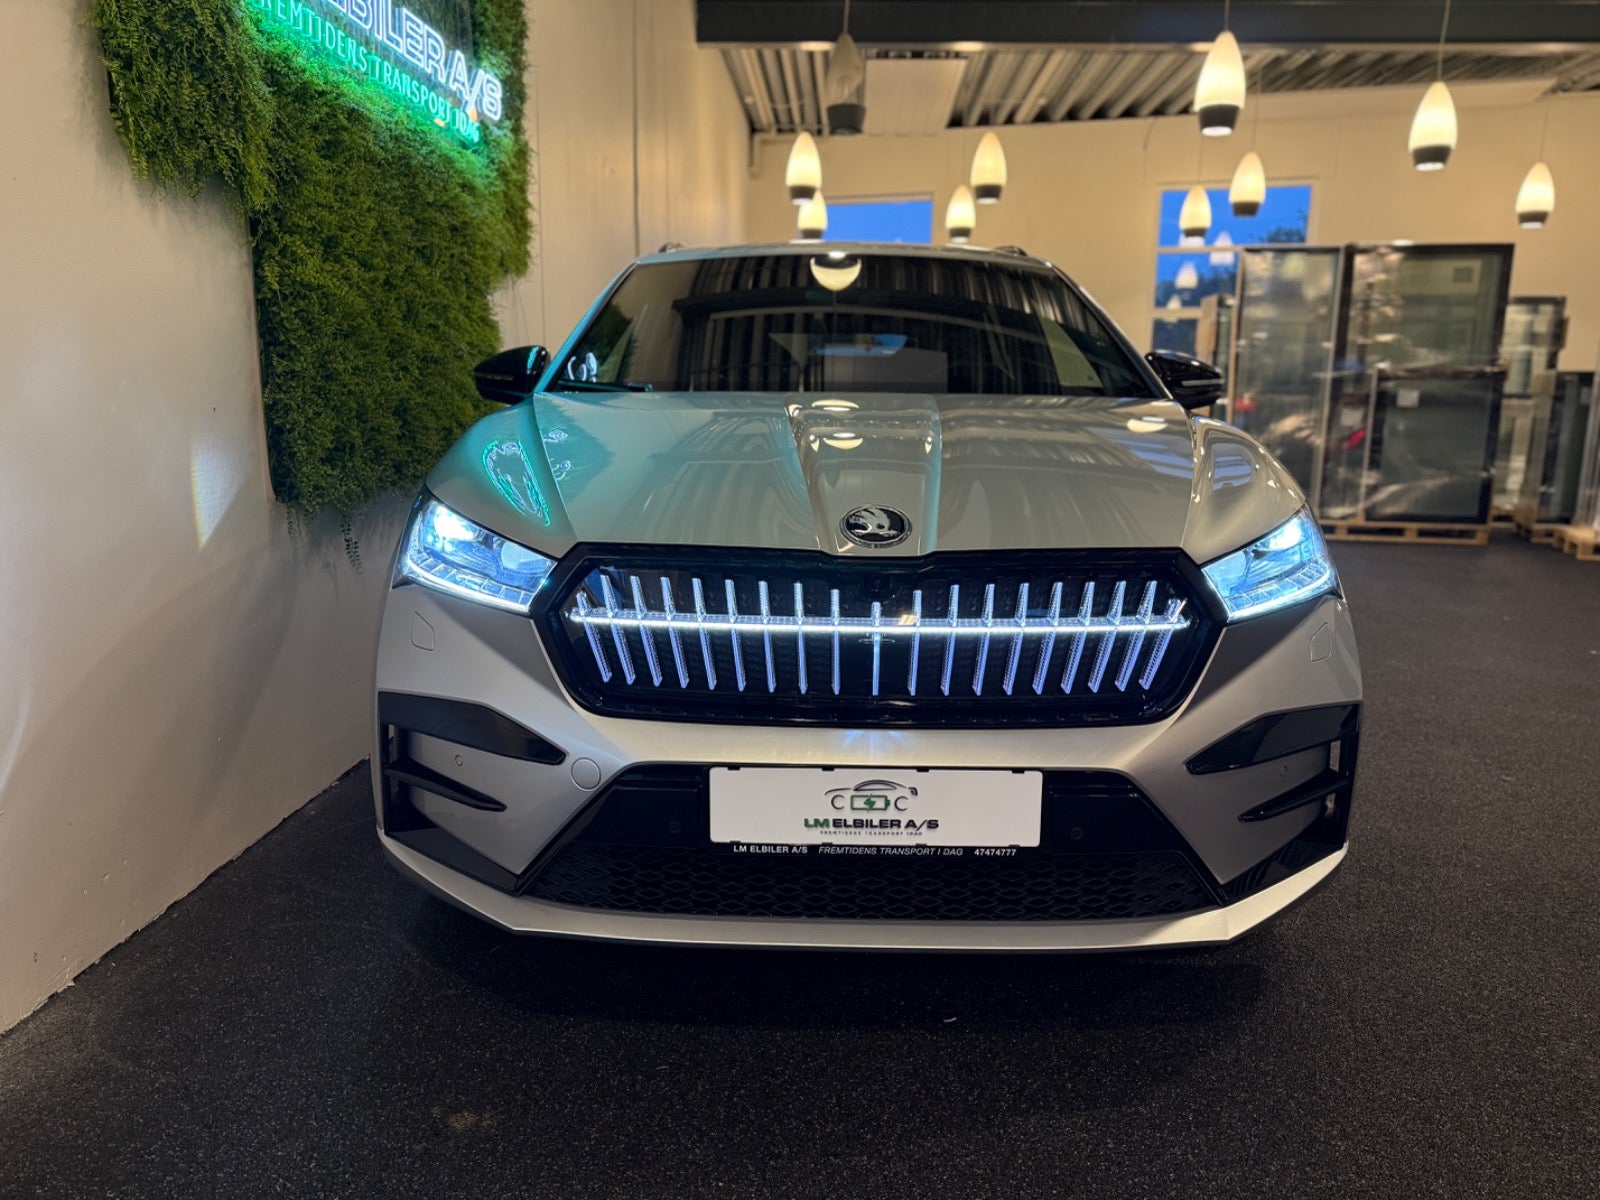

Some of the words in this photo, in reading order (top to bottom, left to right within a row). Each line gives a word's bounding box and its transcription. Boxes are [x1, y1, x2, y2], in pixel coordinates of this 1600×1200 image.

[367, 55, 453, 123] TRANSPORT
[804, 818, 830, 828] LM
[832, 818, 901, 829] ELBILER
[904, 819, 939, 831] A/S
[733, 845, 747, 853] LM
[750, 845, 789, 854] ELBILER
[791, 846, 808, 854] A/S
[818, 846, 877, 855] FREMTIDENS
[880, 847, 935, 856] TRANSPORT
[943, 848, 964, 856] DAG
[974, 848, 1017, 857] 47474777
